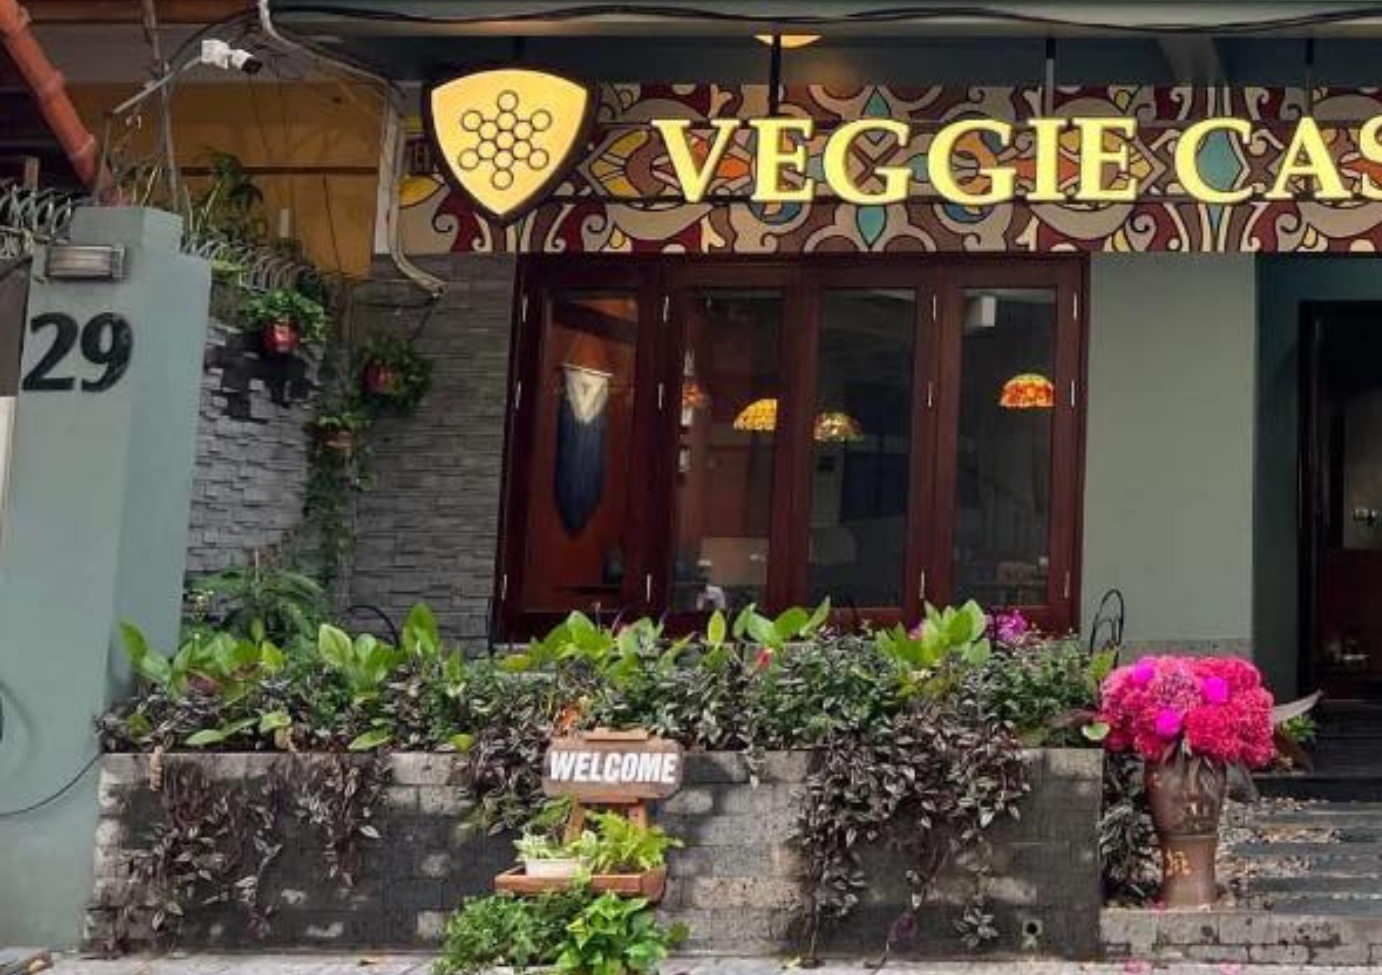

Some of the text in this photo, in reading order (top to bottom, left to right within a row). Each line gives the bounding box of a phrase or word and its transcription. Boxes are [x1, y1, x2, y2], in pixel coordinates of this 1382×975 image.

[651, 116, 1139, 205] VEGGIE
[22, 312, 133, 392] 29
[550, 751, 677, 784] WELCOME
